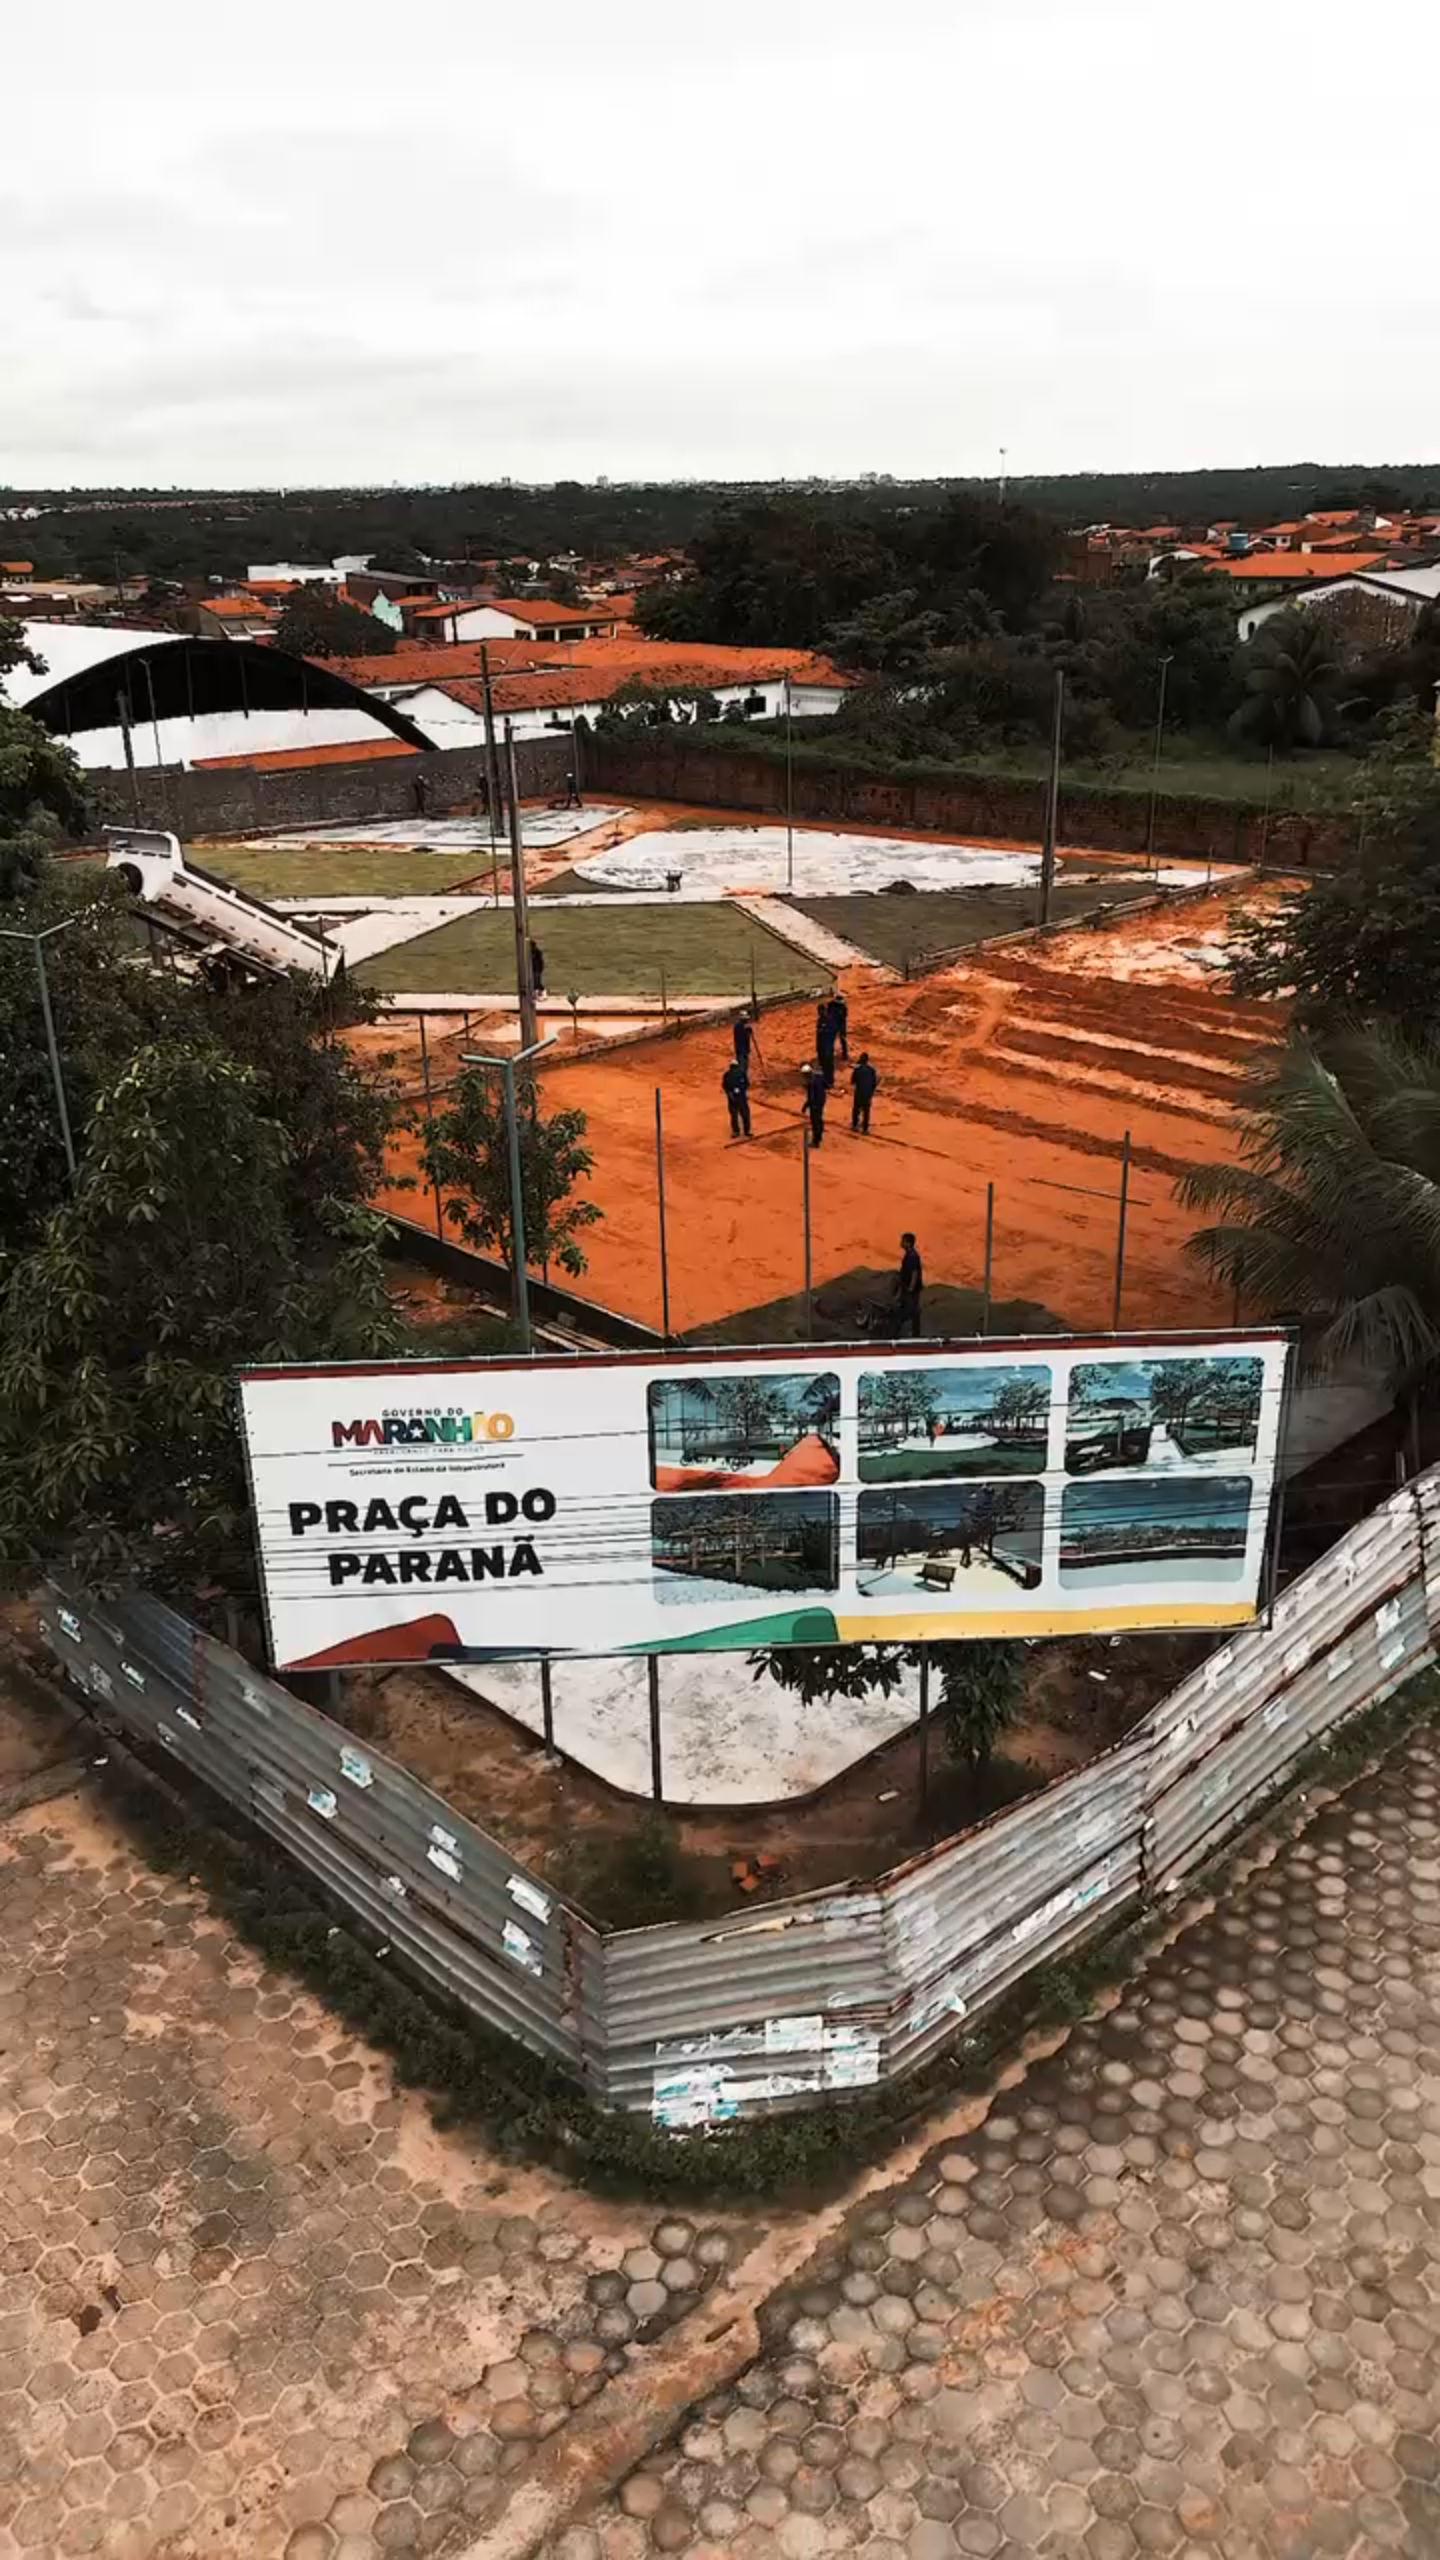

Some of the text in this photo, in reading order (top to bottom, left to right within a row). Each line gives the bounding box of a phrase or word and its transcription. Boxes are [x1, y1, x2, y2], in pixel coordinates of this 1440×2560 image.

[332, 1412, 514, 1447] MARANHÃO
[381, 1407, 464, 1417] GOVERNO DO
[288, 1488, 557, 1537] PRAÇA DO
[328, 1535, 544, 1586] PARANÃ
